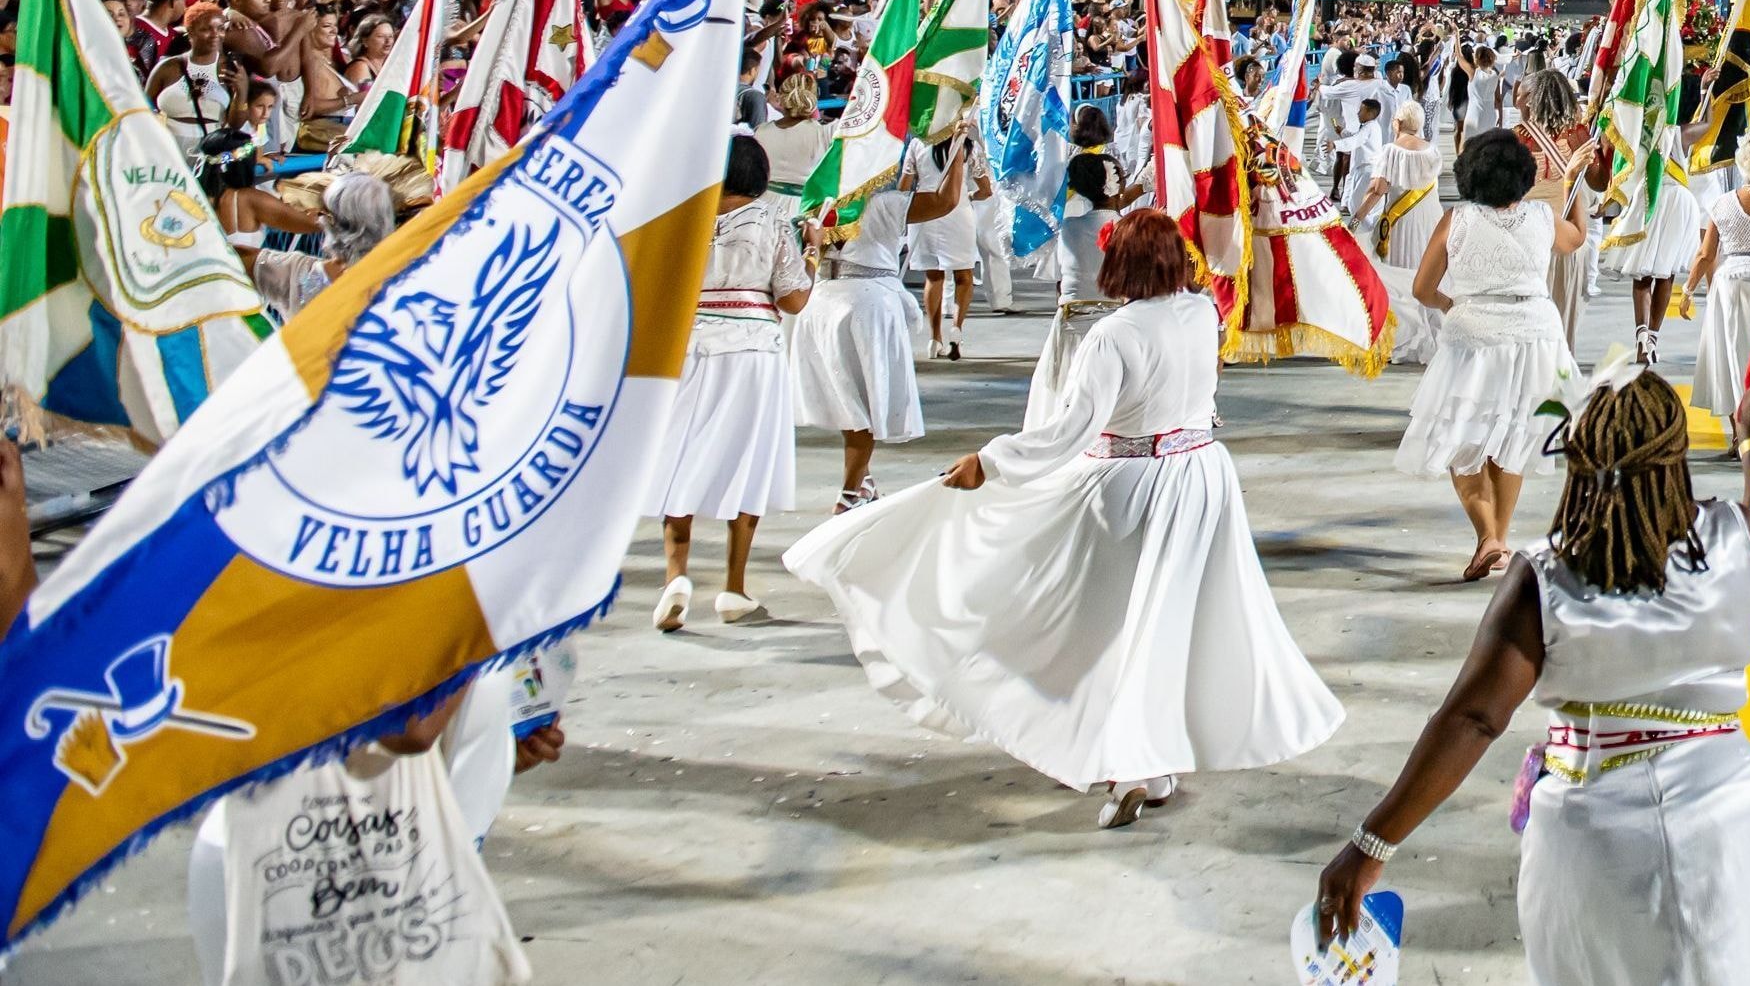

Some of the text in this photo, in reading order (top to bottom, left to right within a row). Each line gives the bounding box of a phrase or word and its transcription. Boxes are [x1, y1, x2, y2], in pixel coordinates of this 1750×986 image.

[122, 165, 188, 193] VELHA
[288, 399, 604, 577] VELHA GUARDA
[264, 906, 442, 986] DEUS
